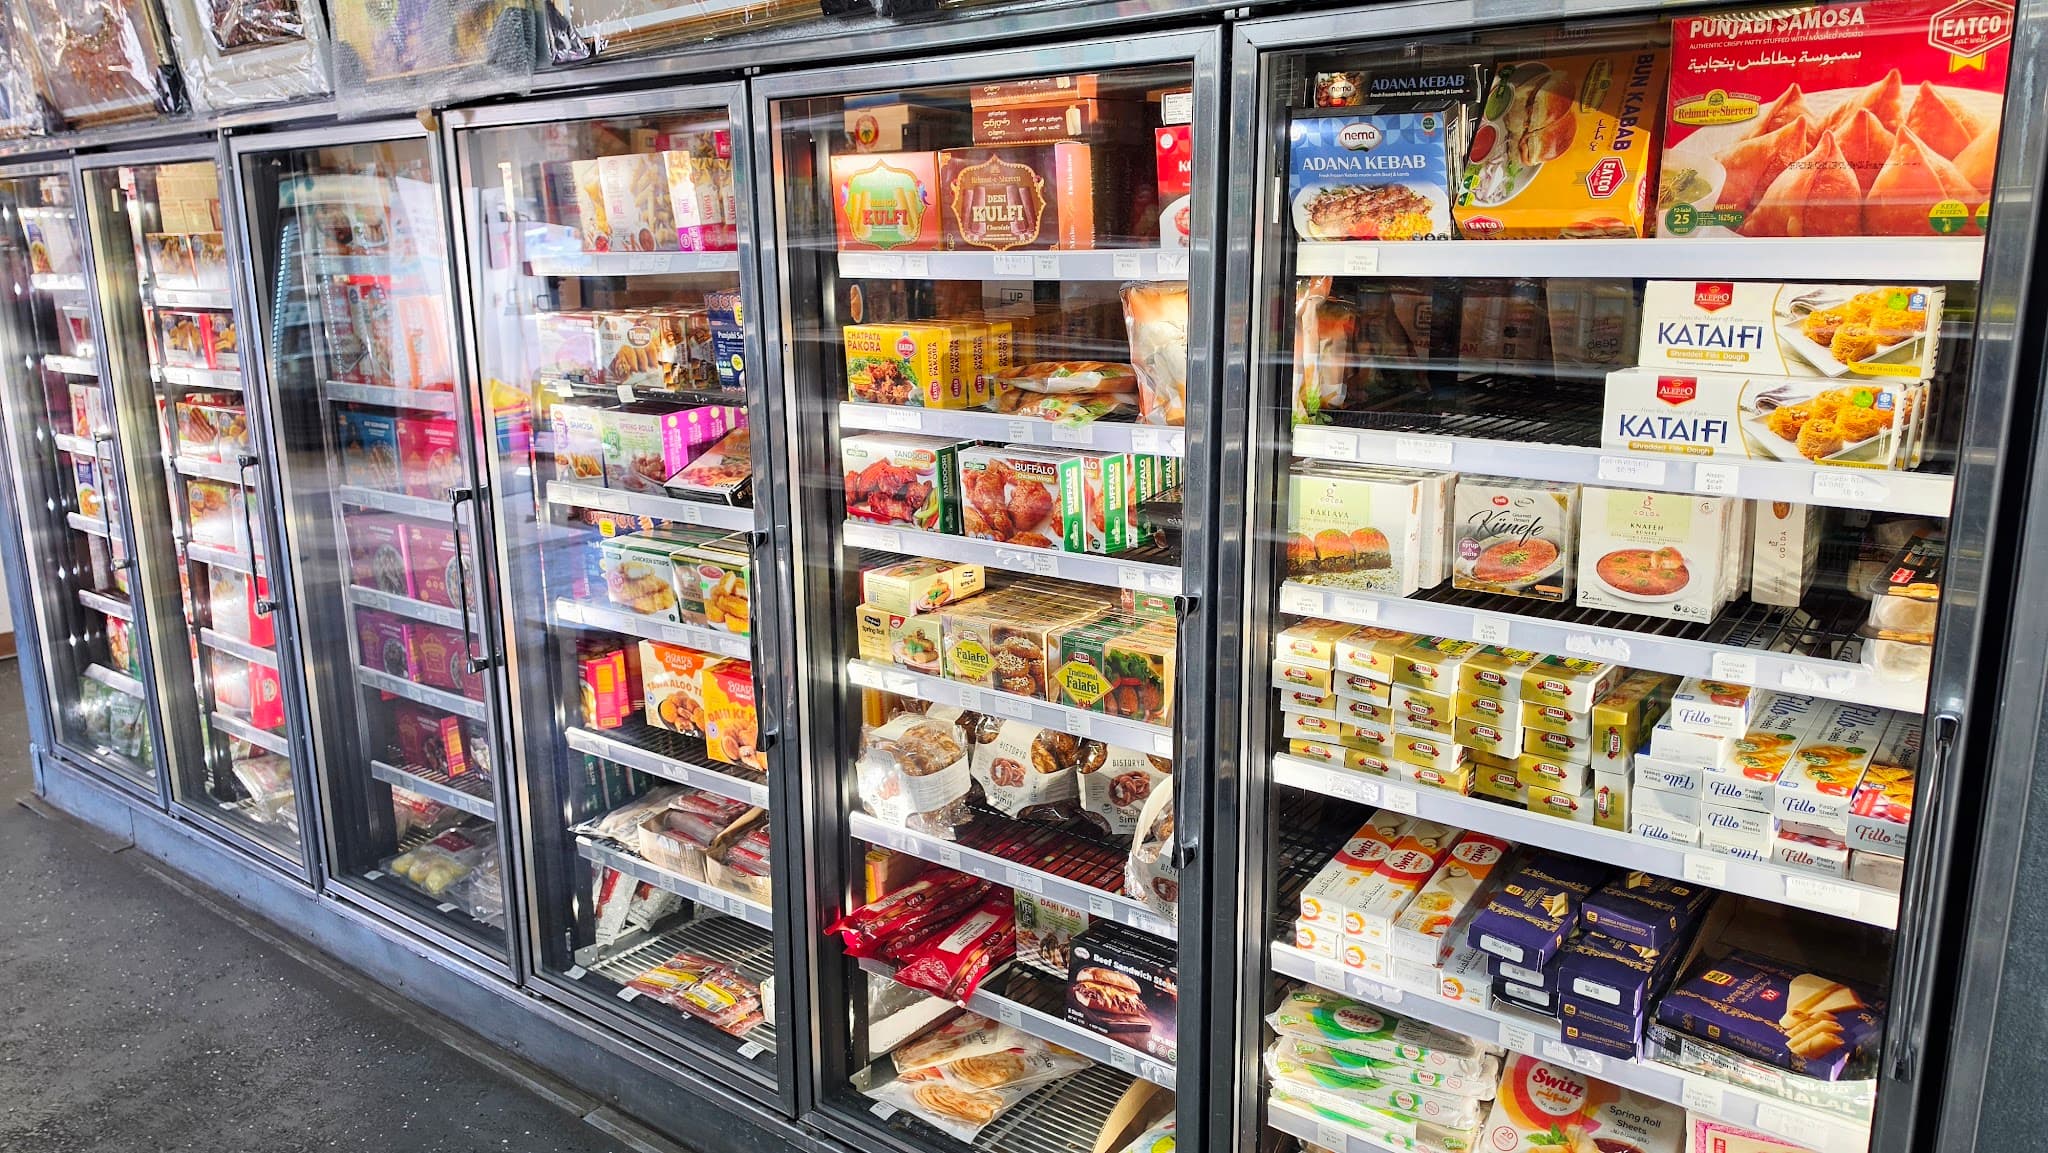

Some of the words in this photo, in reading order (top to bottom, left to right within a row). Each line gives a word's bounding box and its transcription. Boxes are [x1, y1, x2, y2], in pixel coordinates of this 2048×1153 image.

[1690, 18, 1772, 39] PUNJABI
[1776, 7, 1865, 34] SAMOSA
[1942, 15, 2001, 37] EATCO
[1689, 41, 1723, 50] AUTHENTIC
[1723, 40, 1743, 48] CRISPY
[1763, 37, 1789, 45] STUFFED
[1791, 35, 1808, 43] WITH
[1688, 55, 1736, 74] بنجابية
[1737, 51, 1796, 70] بطاطس
[1798, 50, 1862, 67] سمبوسة
[1632, 54, 1655, 88] BUN
[1371, 77, 1416, 90] ADANA
[1420, 75, 1465, 88] KEBAB
[1678, 105, 1753, 119] Rehmat-e-Shereen
[1612, 91, 1646, 151] KABAB
[1344, 130, 1376, 140] nema
[1303, 157, 1362, 170] ADANA
[1365, 155, 1426, 169] KEBAB
[1597, 162, 1616, 193] EATCO
[987, 194, 1007, 203] DESI
[863, 209, 908, 226] KULFI
[972, 205, 1024, 222] KULFI
[1674, 214, 1689, 225] 25
[1009, 292, 1024, 302] UP
[1697, 293, 1729, 302] ALEPPO
[847, 331, 881, 341] CHATPATA
[1658, 322, 1763, 349] KATAIFI
[847, 341, 881, 352] PAKORA
[1723, 353, 1745, 361] Dough
[1619, 414, 1728, 444] KATAIFI
[894, 449, 930, 461] TANDOORI
[1686, 447, 1710, 456] Dough
[1015, 463, 1054, 475] BUFFALO
[1310, 508, 1349, 519] BAKLAVA
[1468, 510, 1544, 547] Künefe
[1630, 523, 1664, 531] KNAFEH
[1779, 531, 1787, 559] GOLDA
[632, 555, 653, 564] CHICKEN
[654, 558, 670, 566] STRIPS
[1582, 591, 1589, 600] 2
[956, 648, 989, 664] Falafel
[1068, 667, 1098, 680] Traditional
[1483, 673, 1499, 681] ZIYAD
[670, 680, 692, 692] ALOO
[1066, 675, 1100, 694] Falafel
[1546, 682, 1563, 690] ZIYAD
[1481, 700, 1496, 709] ZIYAD
[1548, 709, 1564, 717] ZIYAD
[1679, 708, 1711, 724] Fillo
[1836, 704, 1880, 728] Fillo
[1479, 728, 1494, 736] ZIYAD
[1550, 735, 1565, 743] ZIYAD
[1542, 764, 1558, 773] ZIYAD
[1499, 776, 1514, 784] ZIYAD
[1710, 781, 1742, 798] Fillo
[1552, 796, 1569, 805] ZIYAD
[1783, 796, 1816, 814] Fillo
[1708, 812, 1739, 829] Fillo
[1639, 823, 1668, 840] Fillo
[1855, 824, 1891, 843] Fillo
[1352, 839, 1376, 859] Switz
[1469, 844, 1493, 865] Switz
[1781, 848, 1814, 865] Fillo
[1393, 851, 1418, 870] Switz
[1040, 898, 1060, 912] DAHI
[1061, 906, 1081, 920] VADA
[1093, 954, 1112, 967] Beef
[1113, 961, 1152, 982] Sandwich
[1338, 1010, 1380, 1025] Switz
[1532, 1067, 1585, 1099] Switz
[1609, 1105, 1641, 1123] Spring
[1642, 1115, 1662, 1129] Roll
[1501, 1129, 1514, 1140] 20
[1616, 1119, 1647, 1136] Sheets
